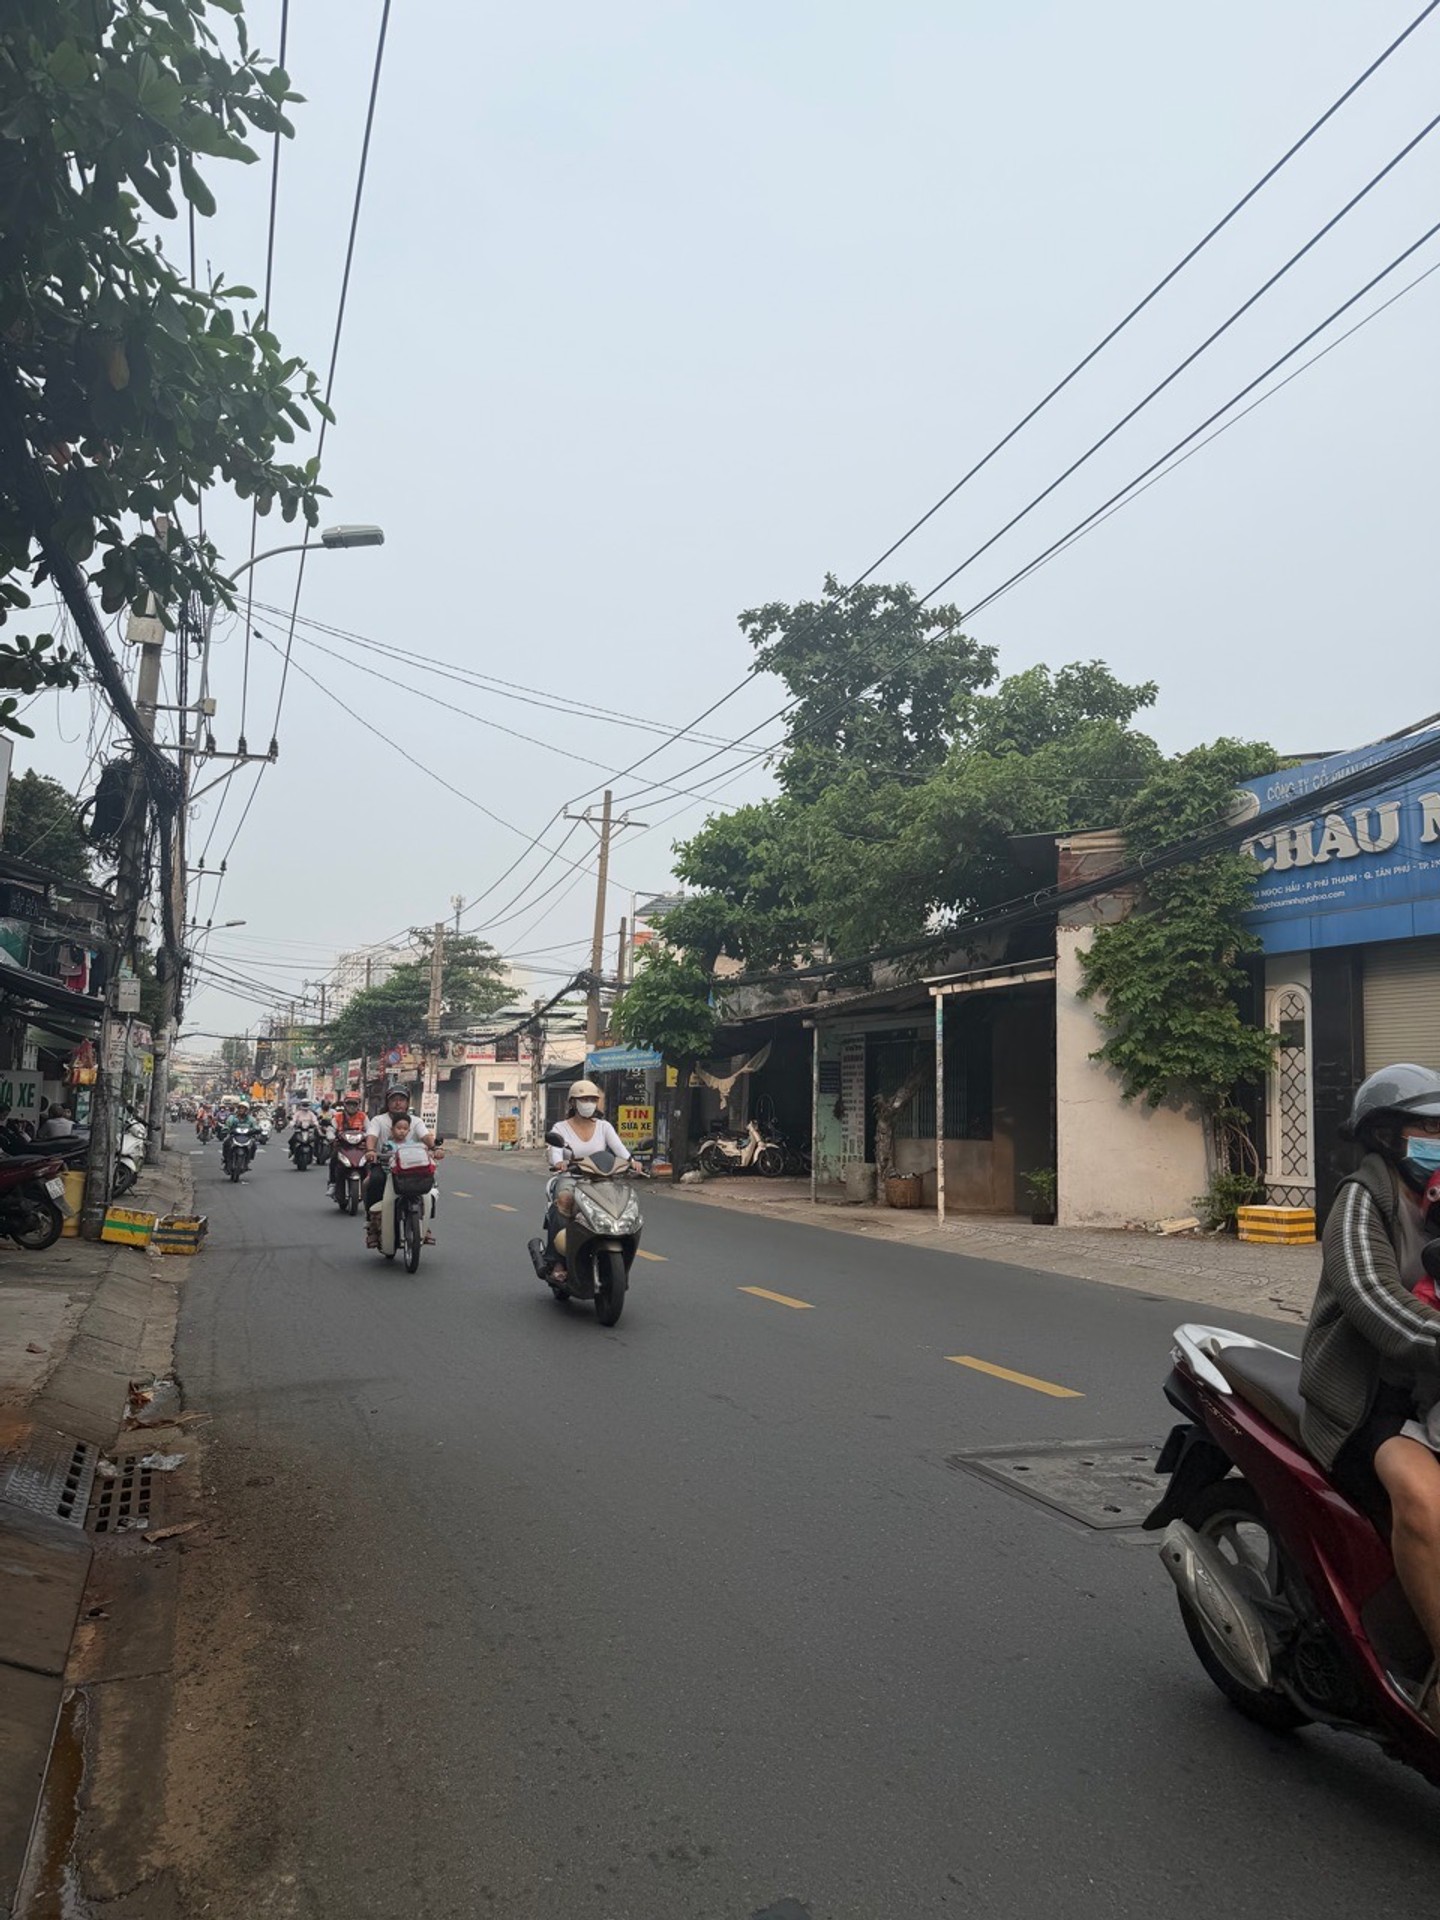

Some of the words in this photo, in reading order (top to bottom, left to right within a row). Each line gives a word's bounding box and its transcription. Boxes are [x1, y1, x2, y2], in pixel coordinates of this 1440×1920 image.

[1297, 777, 1309, 795] TY
[1239, 800, 1400, 875] CHÂU
[17, 1083, 35, 1107] XE
[625, 1107, 649, 1119] TÍN
[640, 1122, 652, 1131] XE
